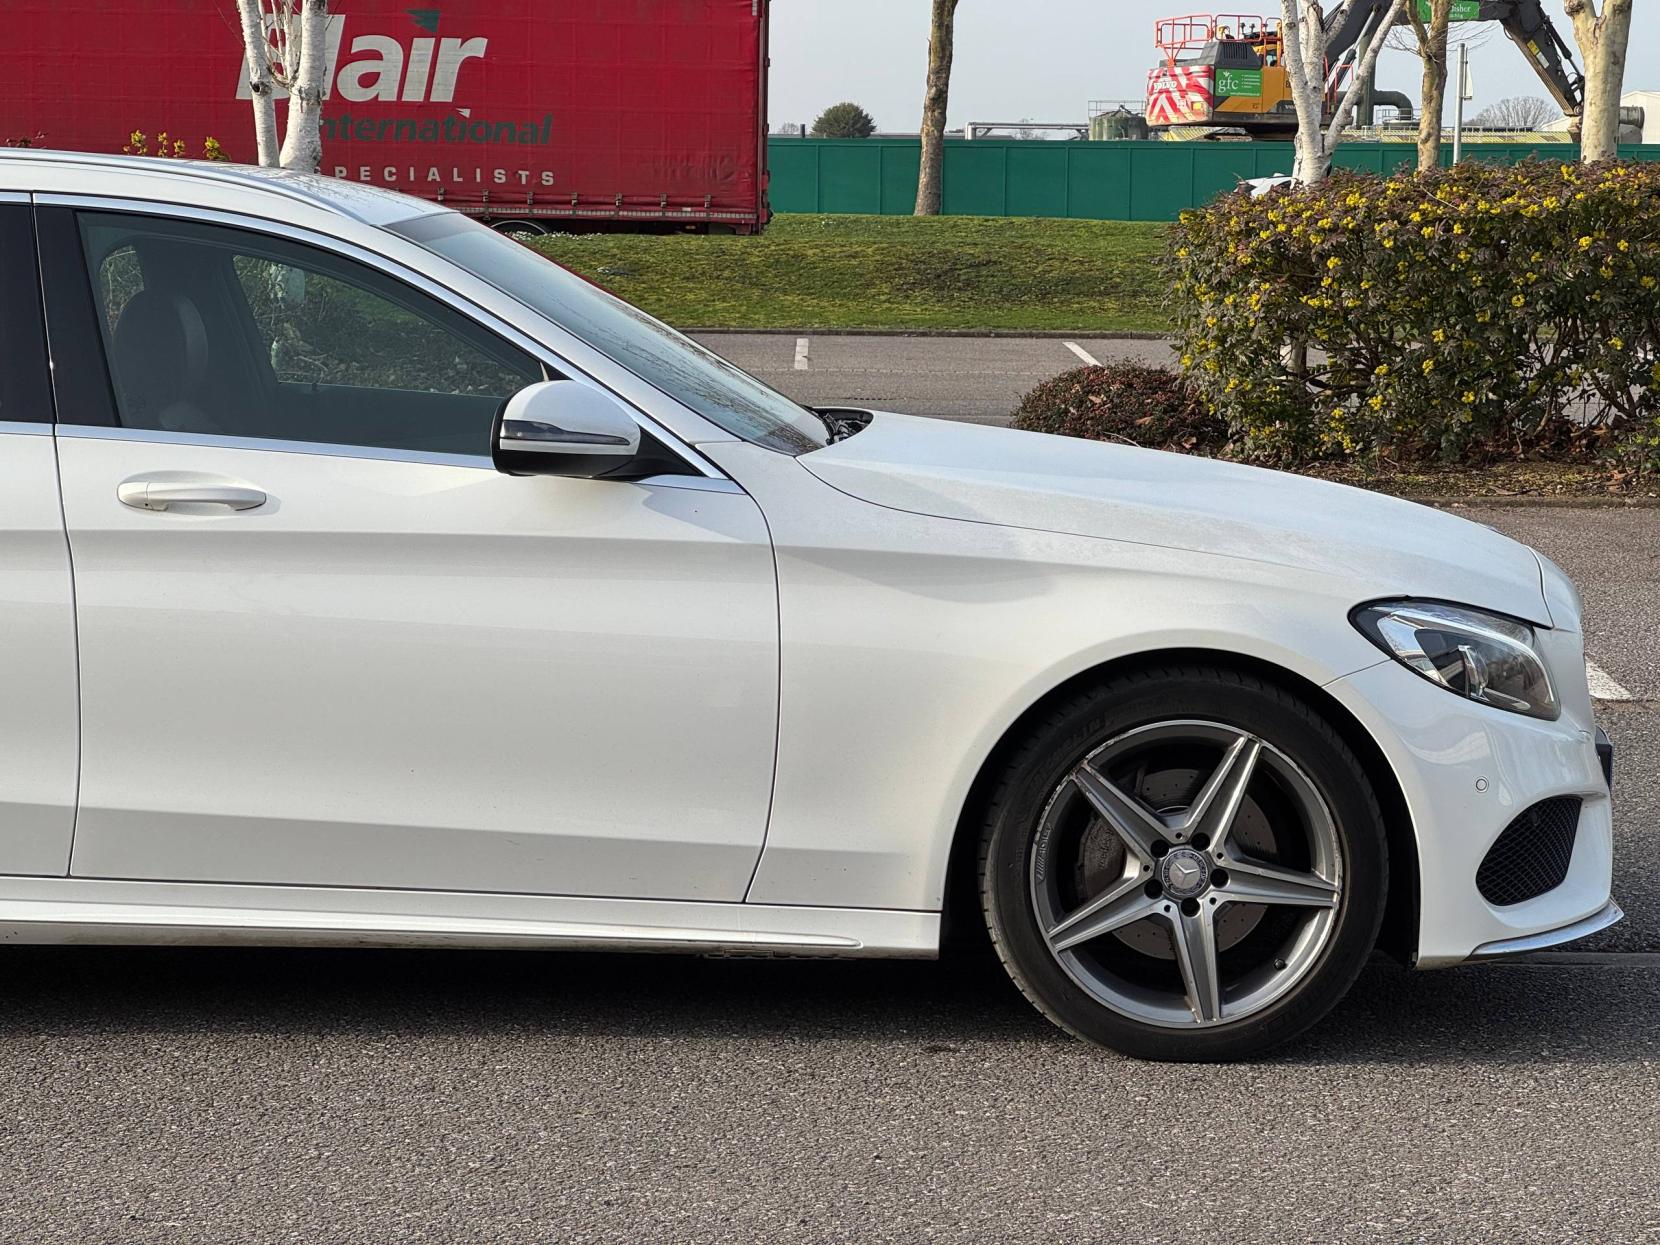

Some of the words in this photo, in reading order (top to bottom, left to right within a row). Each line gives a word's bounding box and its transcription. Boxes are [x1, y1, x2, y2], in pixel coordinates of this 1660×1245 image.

[1218, 74, 1239, 93] gfc
[320, 112, 553, 145] nternational
[315, 166, 555, 186] PECIALISTS
